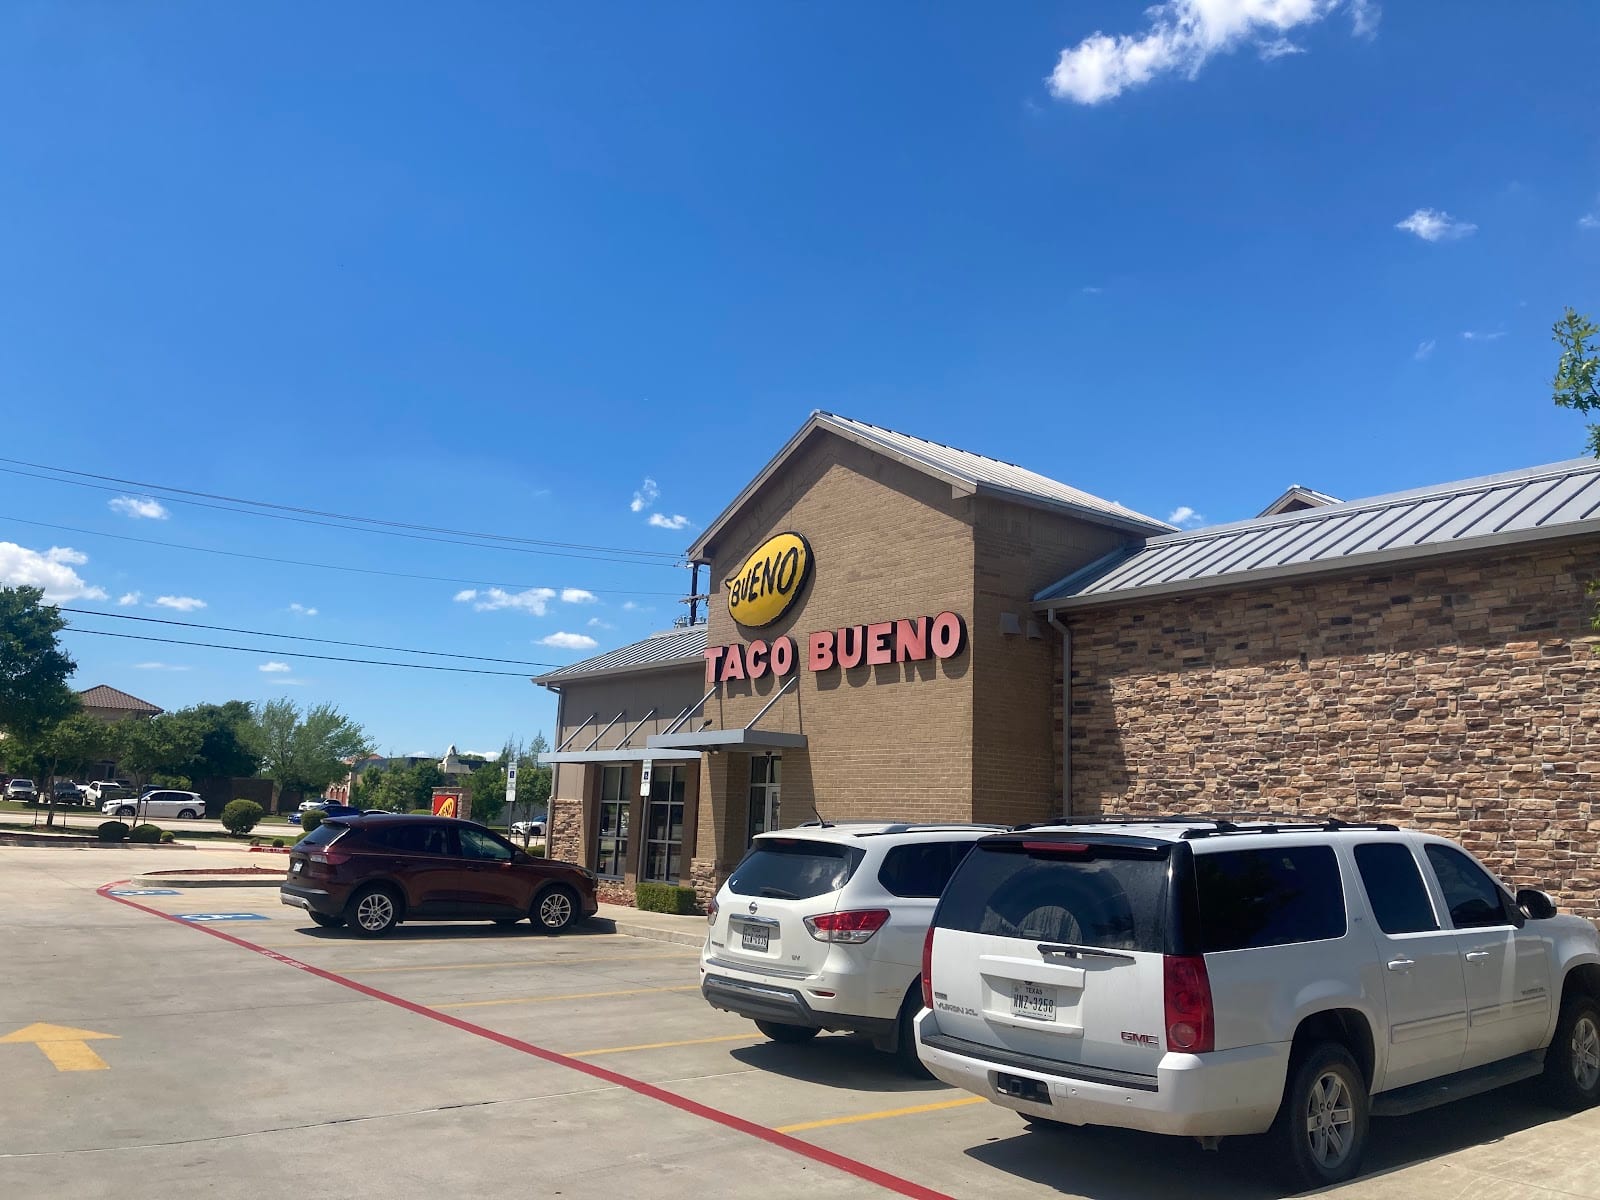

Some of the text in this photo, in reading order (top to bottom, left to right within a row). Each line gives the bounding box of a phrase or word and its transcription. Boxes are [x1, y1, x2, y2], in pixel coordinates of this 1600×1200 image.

[730, 546, 798, 607] BUENO
[704, 611, 964, 683] TACO BUENO
[1025, 987, 1043, 995] TEXAS
[1120, 1031, 1159, 1045] GMC
